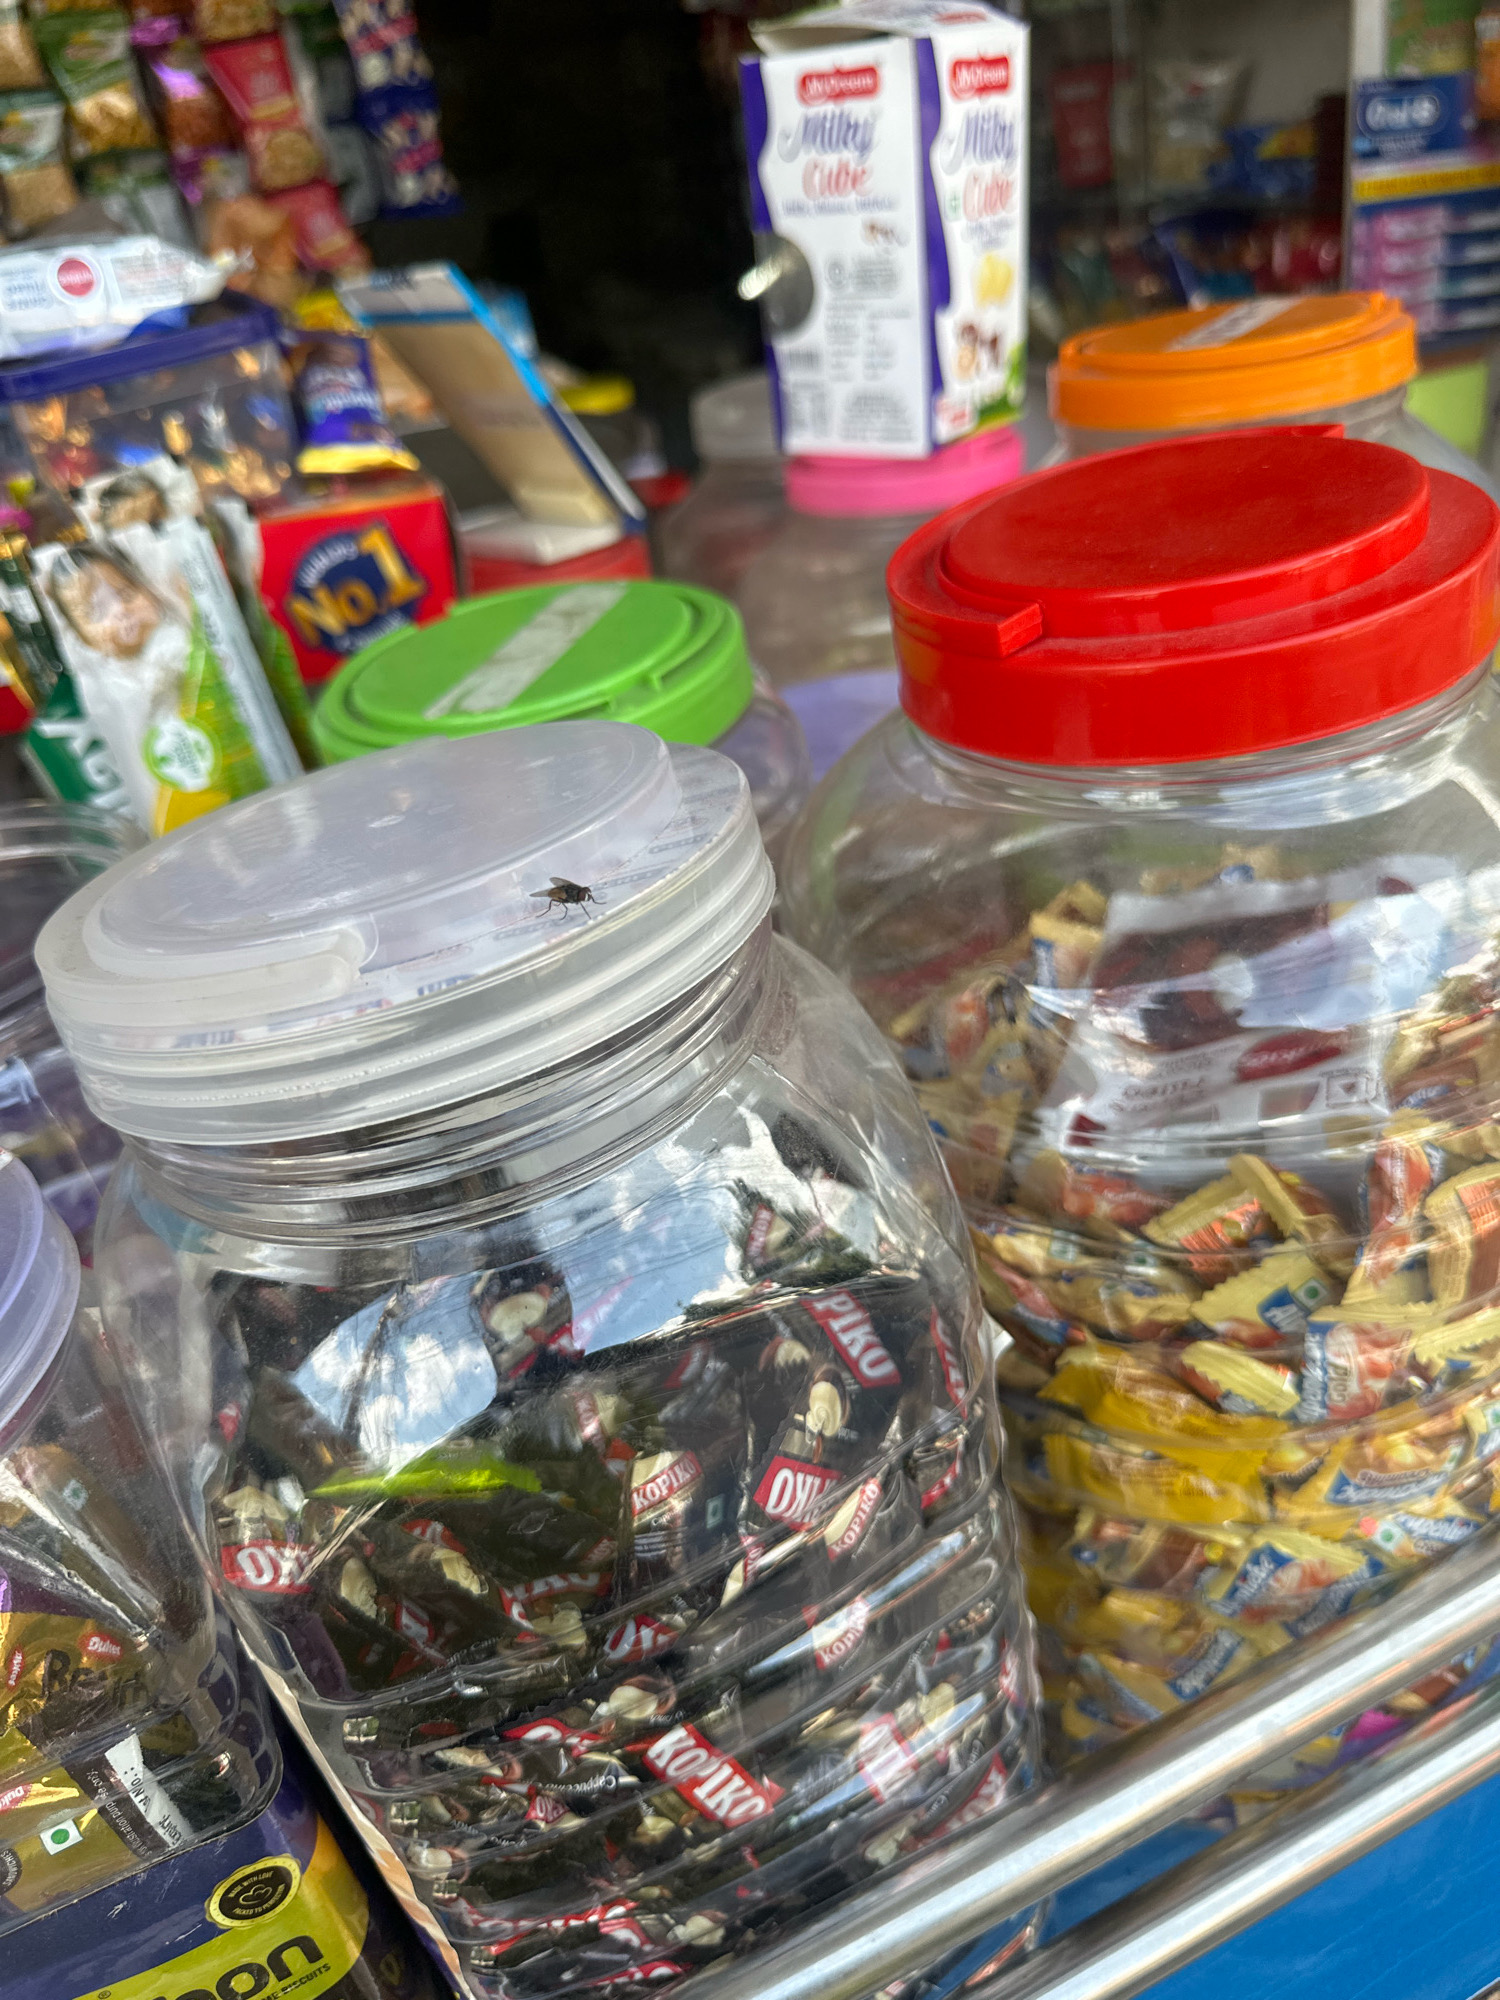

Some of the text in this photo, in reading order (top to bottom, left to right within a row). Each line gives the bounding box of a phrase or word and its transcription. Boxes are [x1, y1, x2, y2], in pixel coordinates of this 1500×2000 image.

[635, 1457, 698, 1512] KOPIKO
[830, 1483, 880, 1554] KOPIKO
[647, 1726, 766, 1820] KOPIKO
[97, 1787, 121, 1820] purpse
[280, 1962, 332, 1993] BISCUITS
